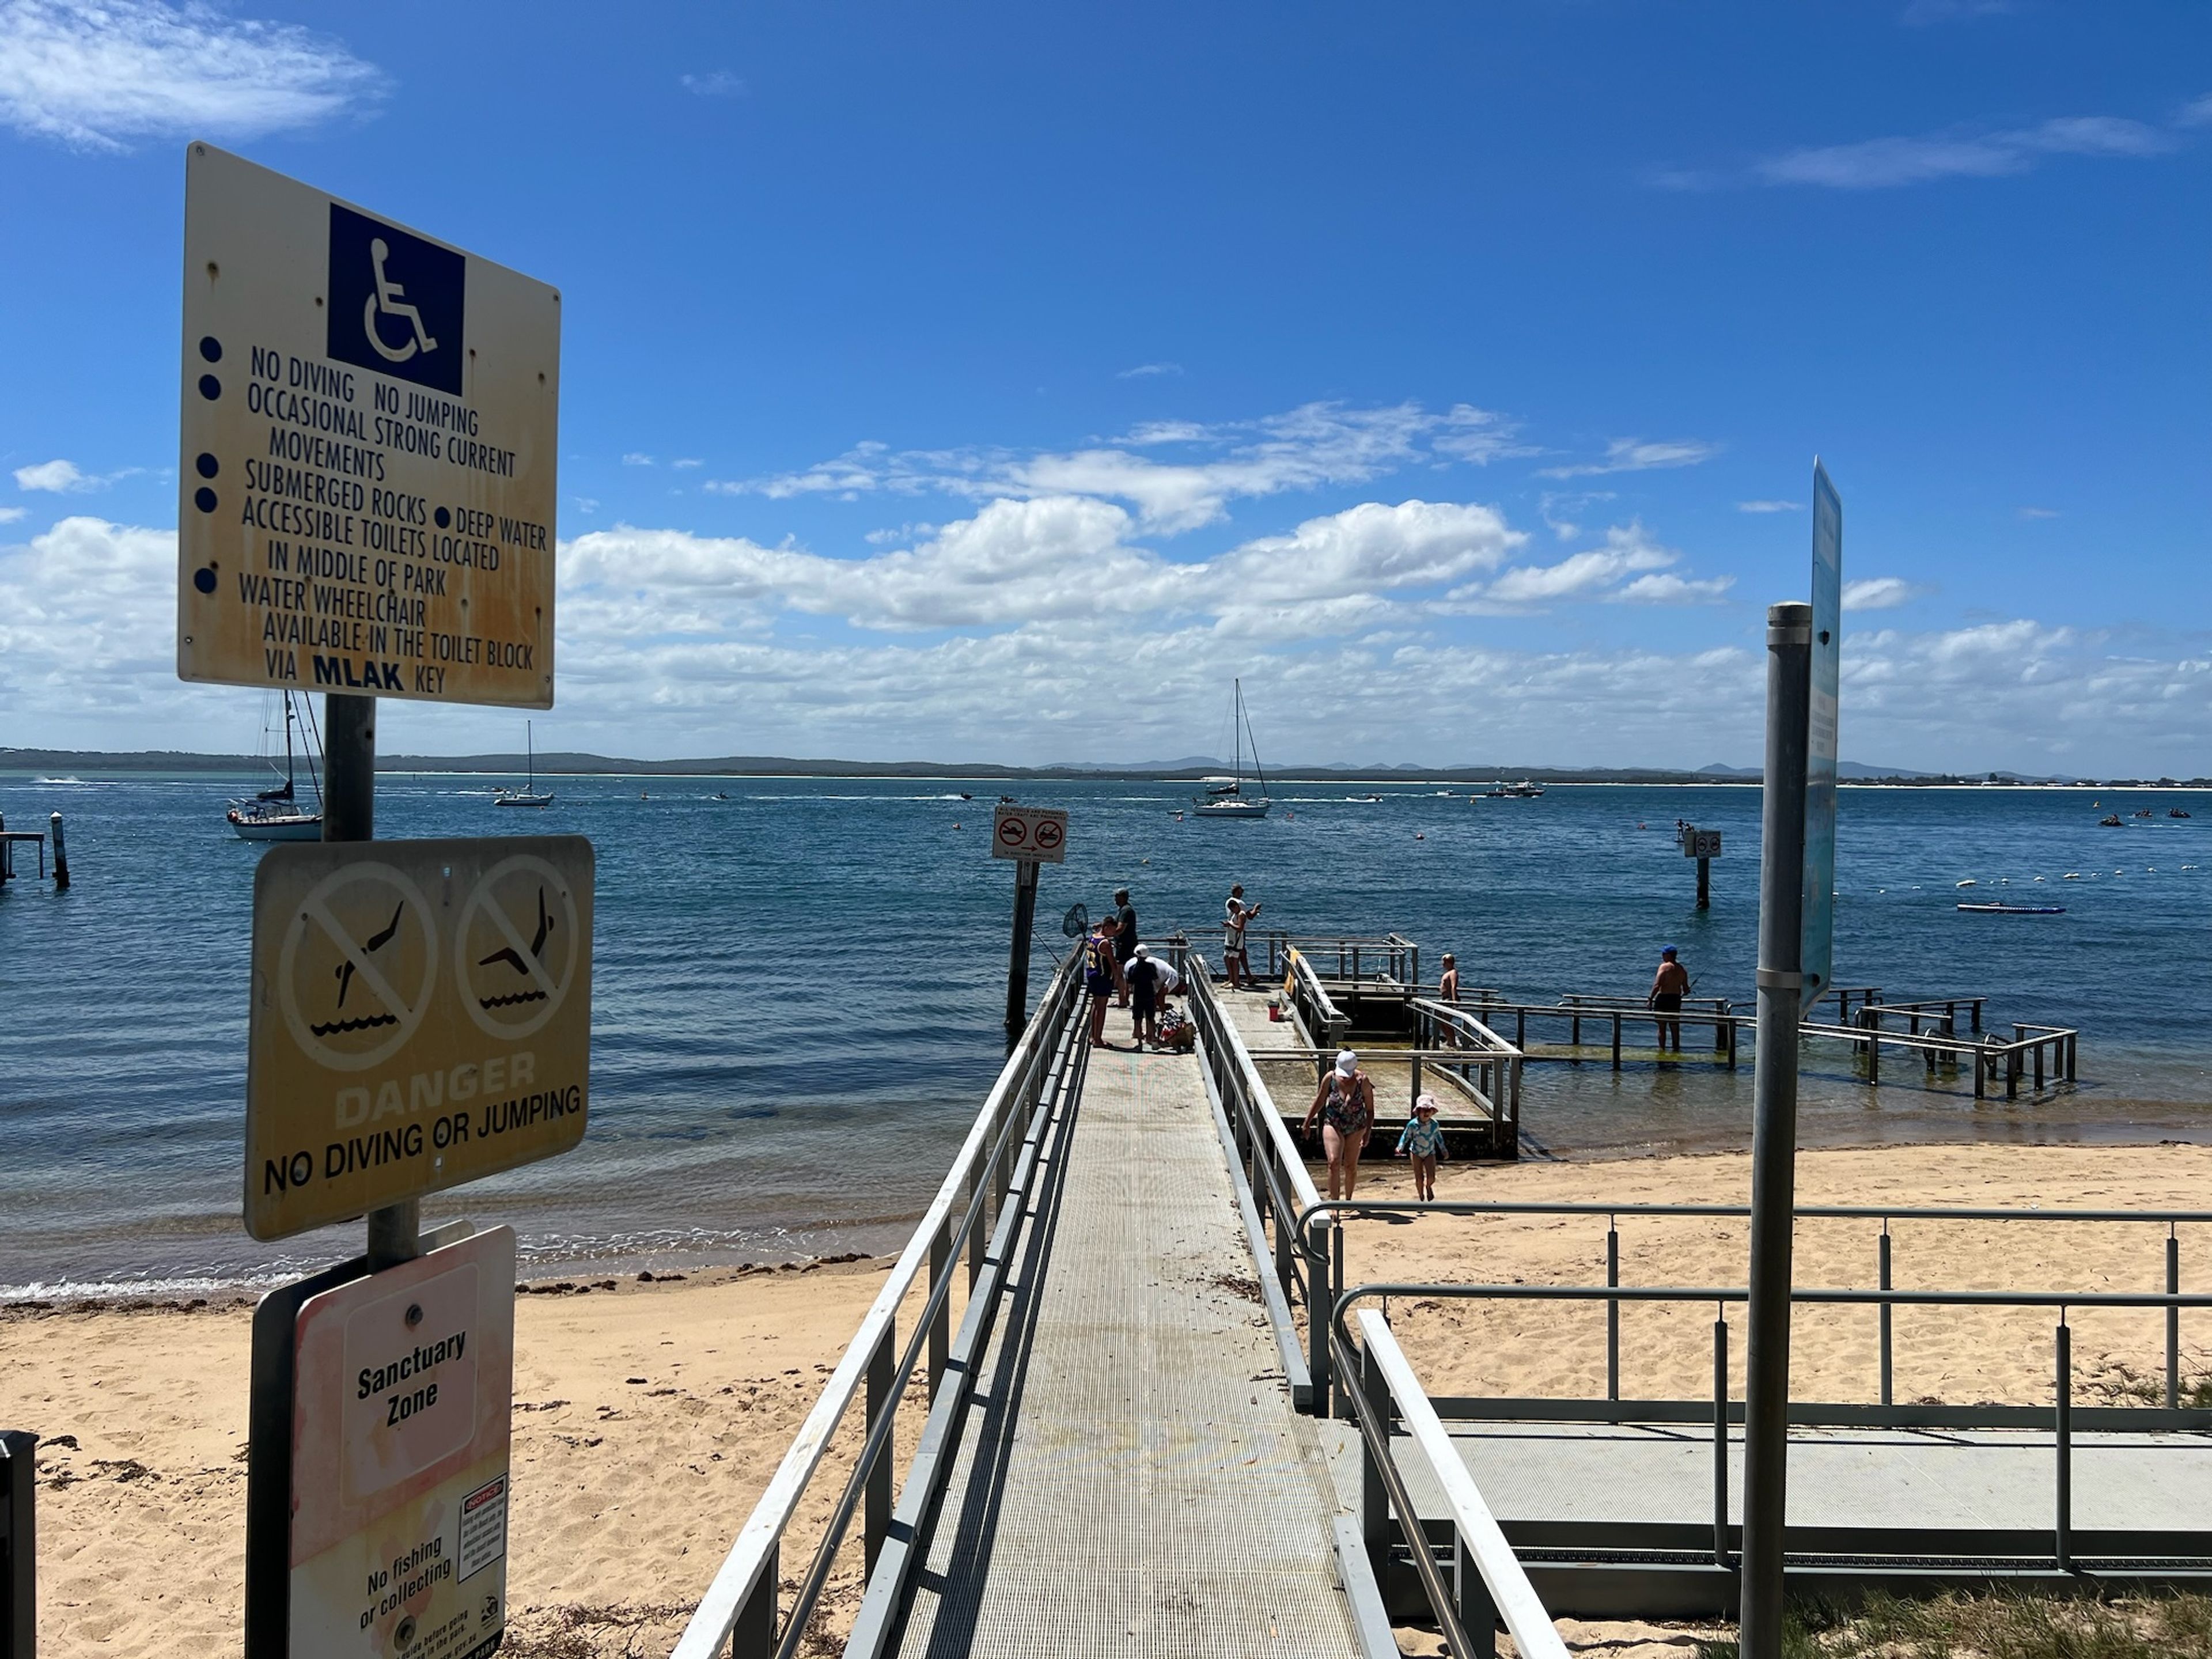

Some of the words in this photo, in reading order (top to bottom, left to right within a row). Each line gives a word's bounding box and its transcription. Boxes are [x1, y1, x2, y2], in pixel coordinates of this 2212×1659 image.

[252, 346, 280, 381] NO
[290, 357, 354, 402] DIVING
[375, 382, 400, 414] NO
[405, 392, 478, 437] JUMPING
[248, 382, 365, 440] OCCASIONAL
[375, 417, 440, 459] STRONG
[448, 436, 515, 478] CURRENT
[270, 427, 384, 482] MOVEMENTS
[245, 459, 363, 512] SUBMERGED
[373, 488, 426, 526] ROCKS
[241, 496, 353, 545] ACCESSIBLE
[362, 519, 425, 559] TOILETS
[433, 534, 499, 571] LOCATED
[456, 507, 494, 539] DEEP
[499, 517, 546, 551] WATER
[269, 540, 287, 571] IN
[297, 546, 366, 585] MIDDLE
[375, 559, 396, 588] OF
[405, 563, 446, 596] PARK
[239, 573, 305, 611] WATER
[314, 584, 425, 627] WHEELCHAIR
[263, 612, 361, 650] AVAILABLE
[369, 626, 385, 653] IN
[395, 628, 423, 657] THE
[431, 633, 486, 665] TOILET
[488, 641, 532, 670] BLOCK
[266, 649, 297, 680] VIA
[313, 655, 404, 691] MLAK
[415, 664, 445, 694] KEY
[335, 1051, 536, 1130] DANGER
[264, 1150, 312, 1194] NO
[325, 1124, 423, 1179] DIVING
[433, 1112, 469, 1149] OR
[478, 1085, 581, 1139] JUMPING
[358, 1331, 466, 1399] Sanctuary
[387, 1384, 438, 1427] Zone
[361, 1606, 376, 1629] or
[381, 1558, 450, 1615] collecting
[368, 1571, 387, 1596] No
[393, 1536, 441, 1580] fishing
[424, 1623, 446, 1646] before
[449, 1610, 468, 1630] going
[437, 1635, 447, 1650] the
